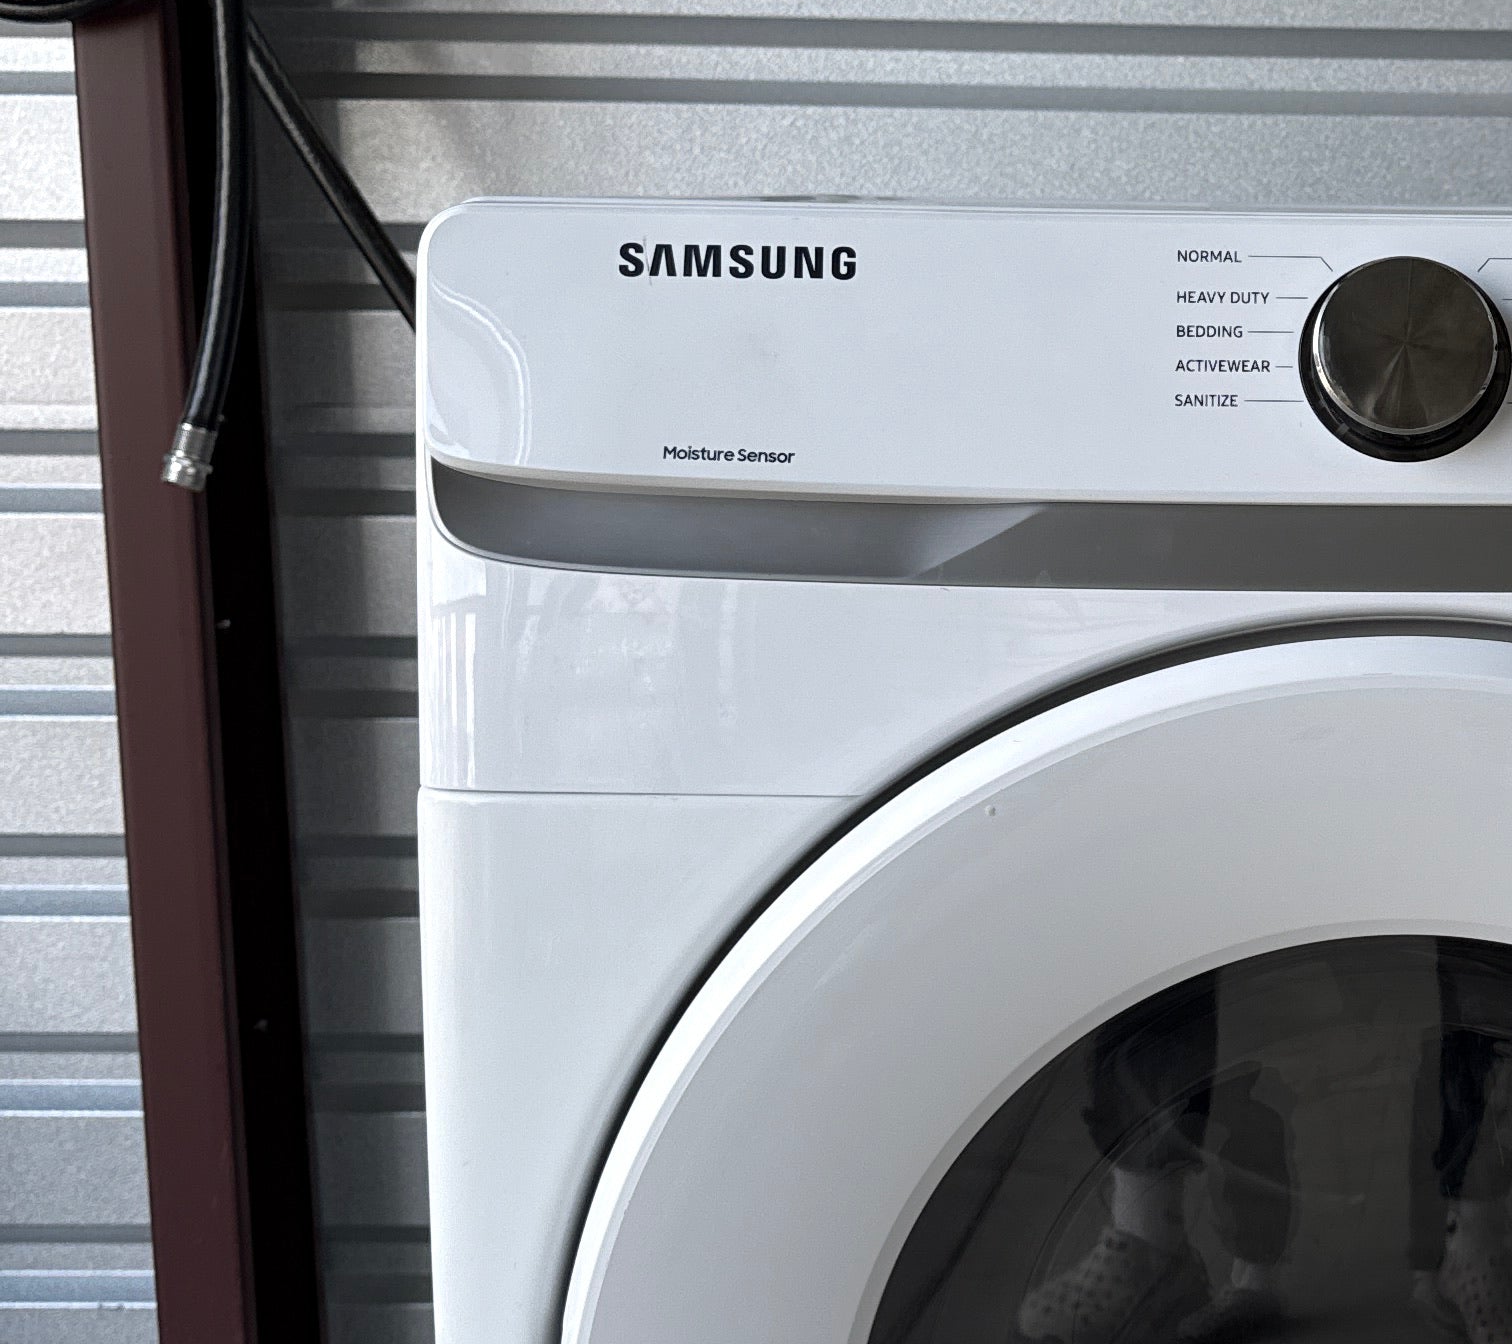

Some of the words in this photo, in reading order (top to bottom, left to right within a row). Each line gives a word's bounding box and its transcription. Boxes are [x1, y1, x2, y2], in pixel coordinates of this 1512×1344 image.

[618, 242, 857, 281] SAMSUNG
[1177, 250, 1243, 264] NORMAL
[1176, 291, 1227, 304] HEAVY
[1230, 292, 1270, 304] DUTY
[1176, 325, 1244, 339] BEDDING
[1175, 359, 1272, 373] ACTIVEWEAR
[1174, 394, 1239, 408] SANITIZE
[662, 445, 736, 462] Moisture
[737, 448, 796, 464] Sensor
